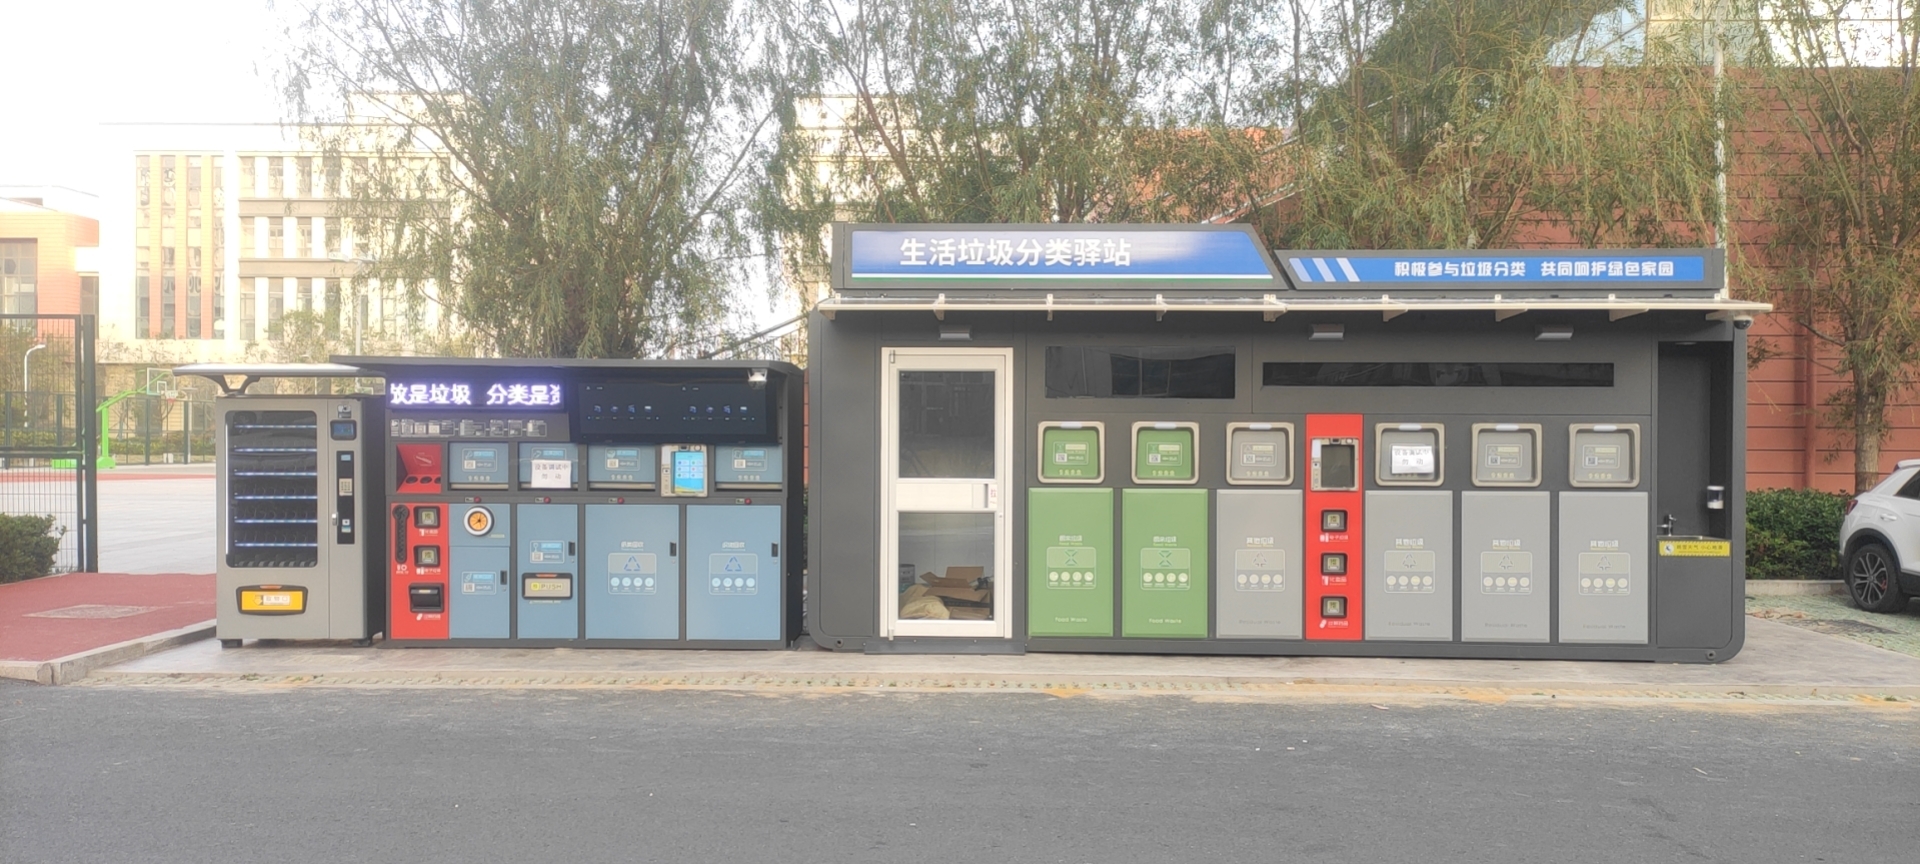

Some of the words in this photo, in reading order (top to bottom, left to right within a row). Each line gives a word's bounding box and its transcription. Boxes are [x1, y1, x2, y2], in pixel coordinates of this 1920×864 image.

[900, 238, 1132, 267] 生活垃圾分类驿站
[1394, 261, 1526, 277] 积极参与垃圾分类
[1540, 261, 1674, 277] 共同呵护绿色家园
[390, 383, 472, 405] 放是垃圾
[534, 463, 569, 471] 设备调试中
